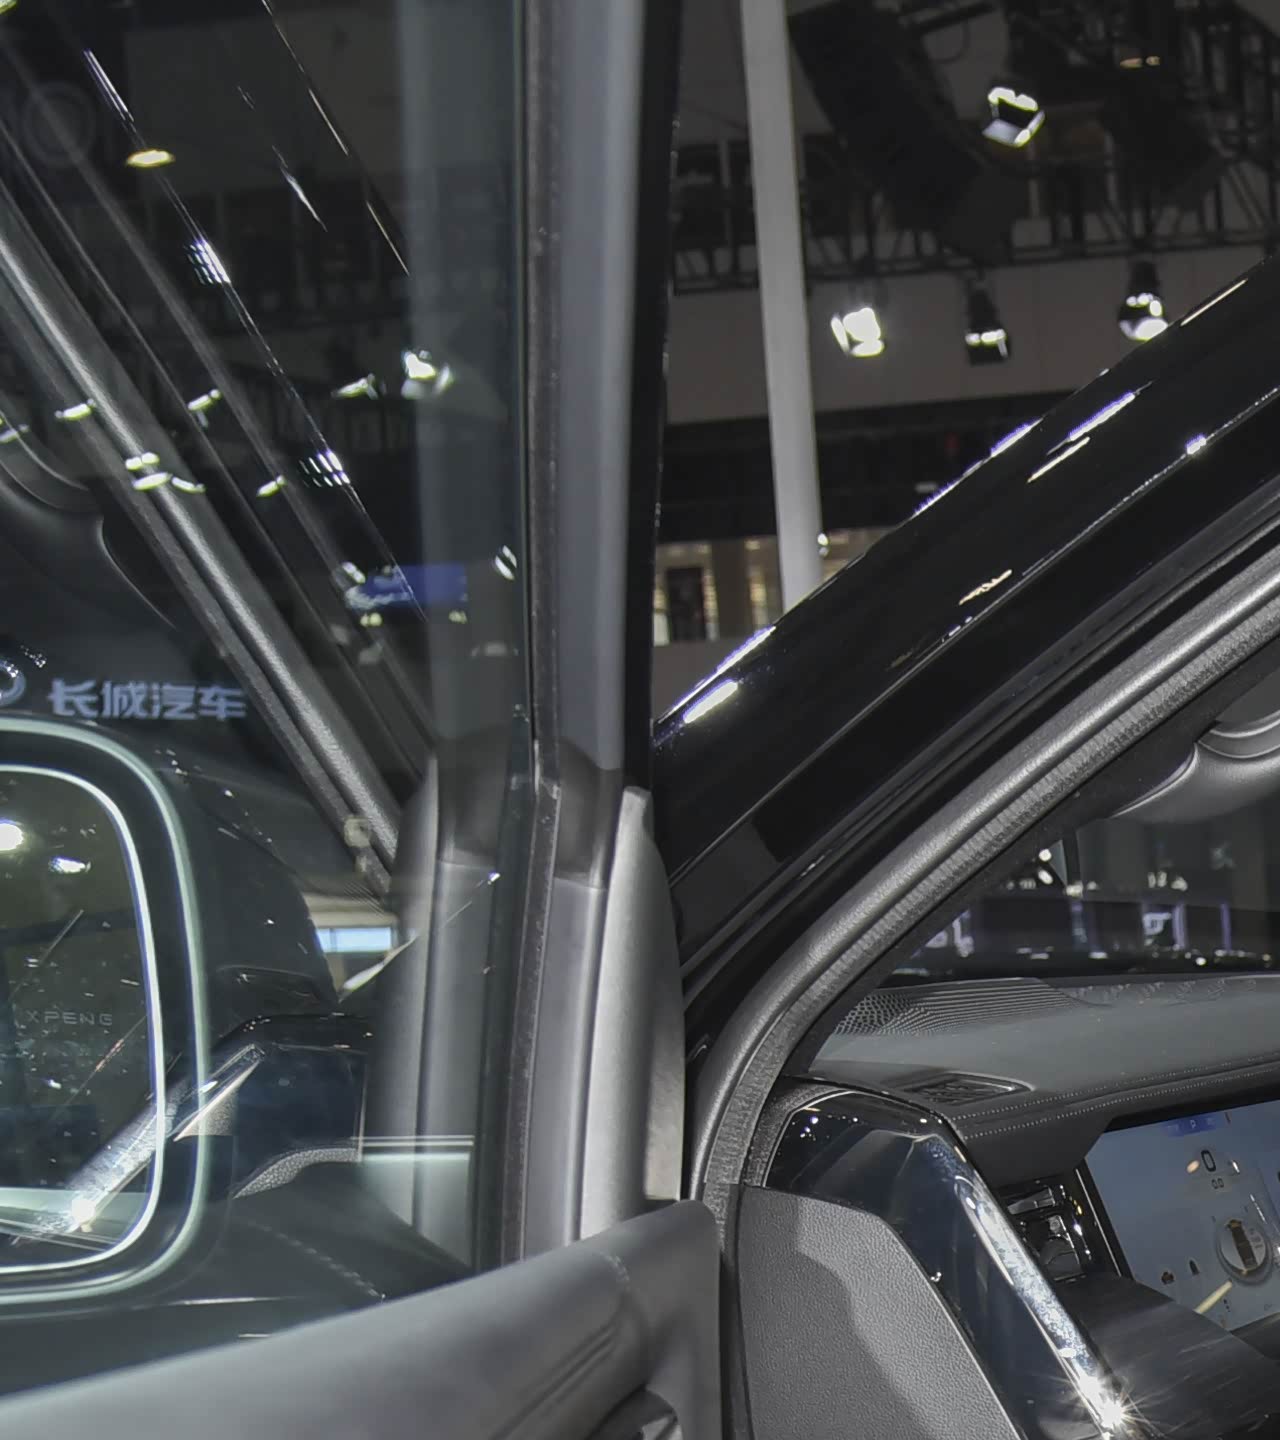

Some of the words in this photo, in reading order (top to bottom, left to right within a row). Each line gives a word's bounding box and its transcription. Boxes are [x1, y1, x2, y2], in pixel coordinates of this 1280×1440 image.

[48, 679, 247, 721] 长城汽车
[25, 1010, 113, 1027] XPENG
